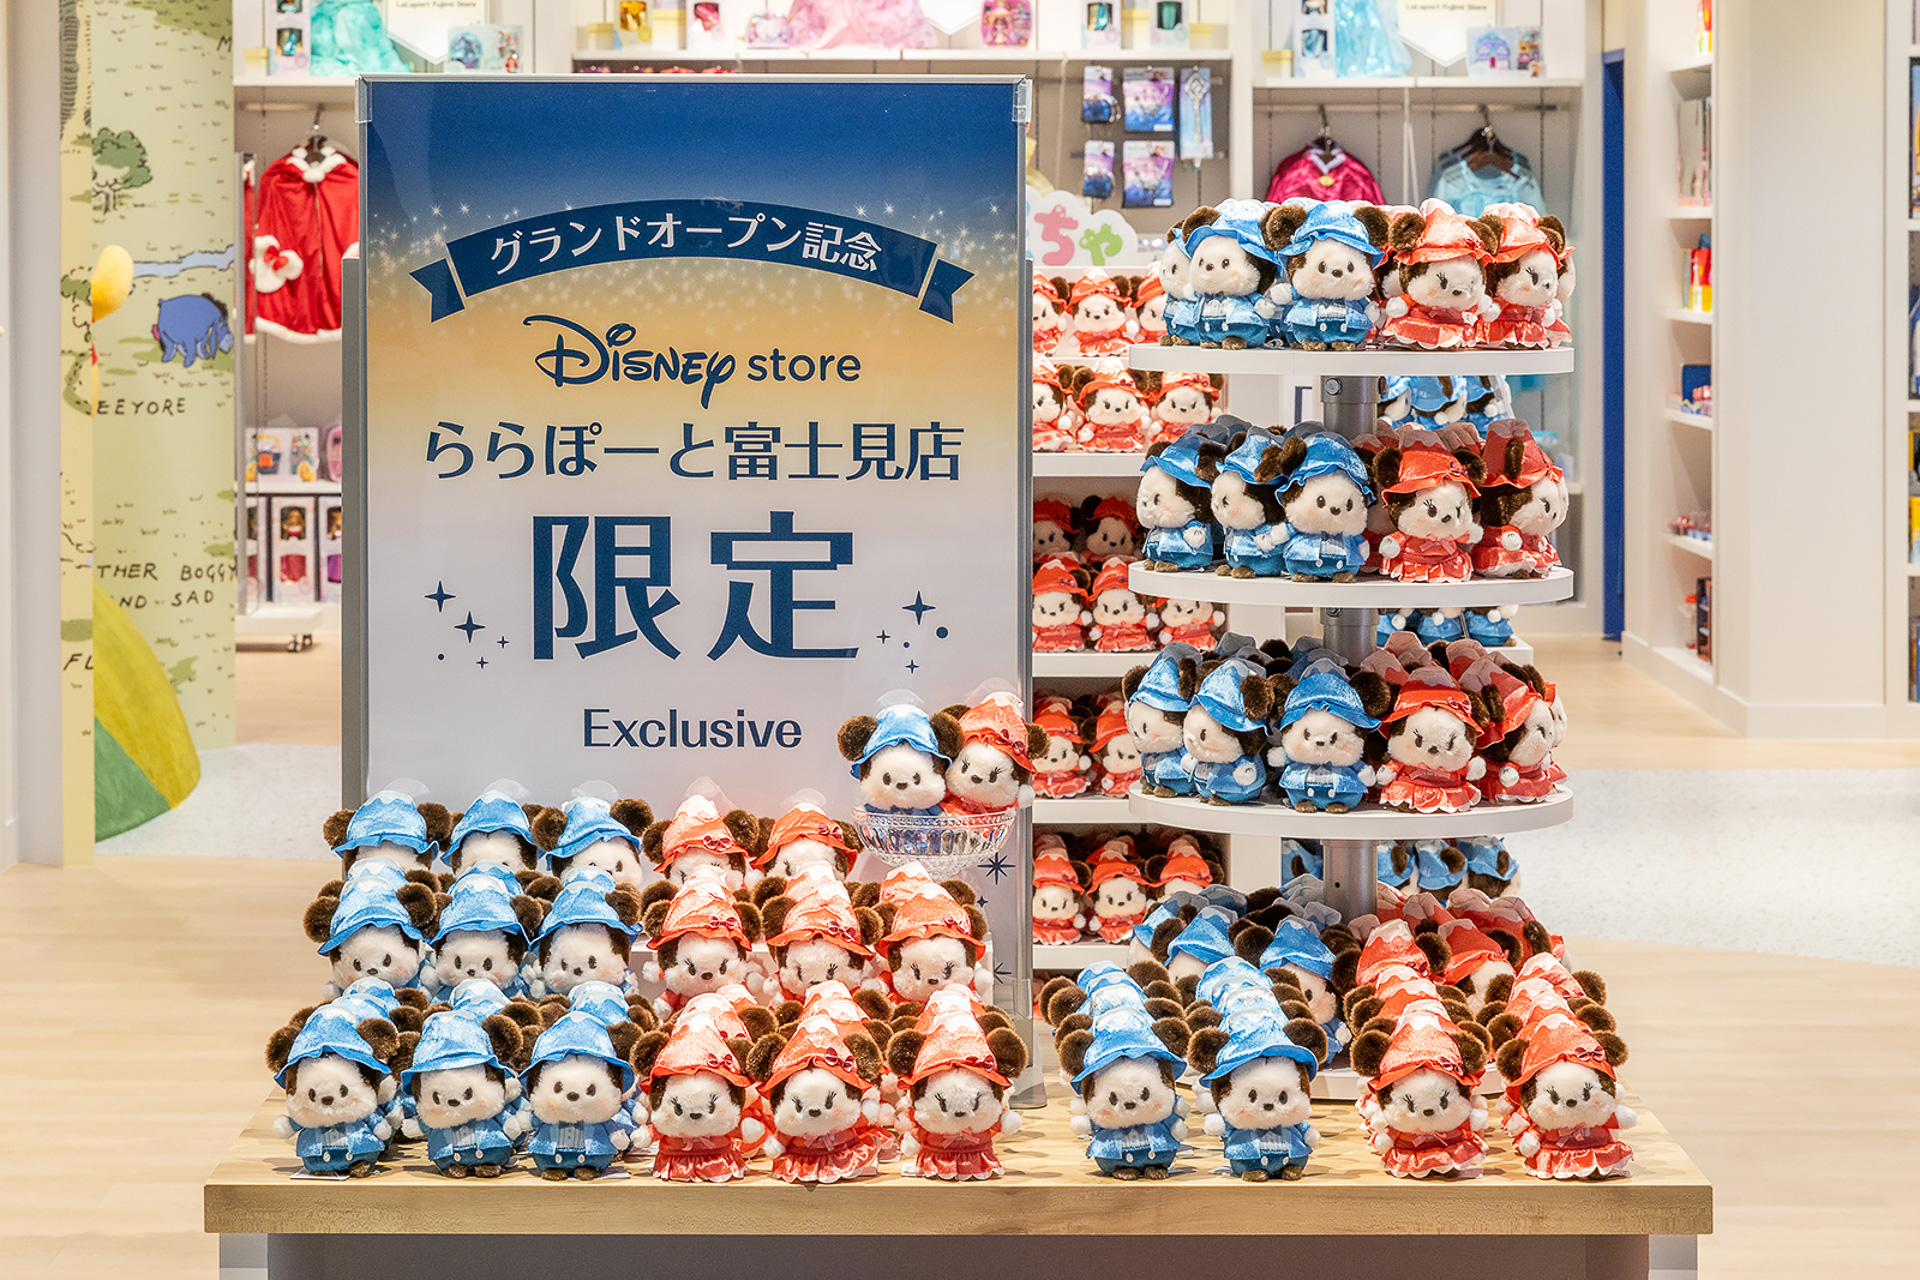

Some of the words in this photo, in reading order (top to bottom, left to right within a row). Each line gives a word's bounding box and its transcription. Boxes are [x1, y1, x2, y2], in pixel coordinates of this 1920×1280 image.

[489, 211, 883, 275] グランドオープン記念
[1026, 200, 1123, 267] ちゃ
[523, 314, 736, 409] Disney
[747, 347, 861, 382] store
[96, 397, 186, 416] EEYORE
[425, 420, 965, 481] ららぽーと富士見店
[110, 594, 147, 609] ND
[171, 590, 215, 607] SAD
[532, 510, 860, 661] 限定
[583, 707, 803, 748] Exclusive
